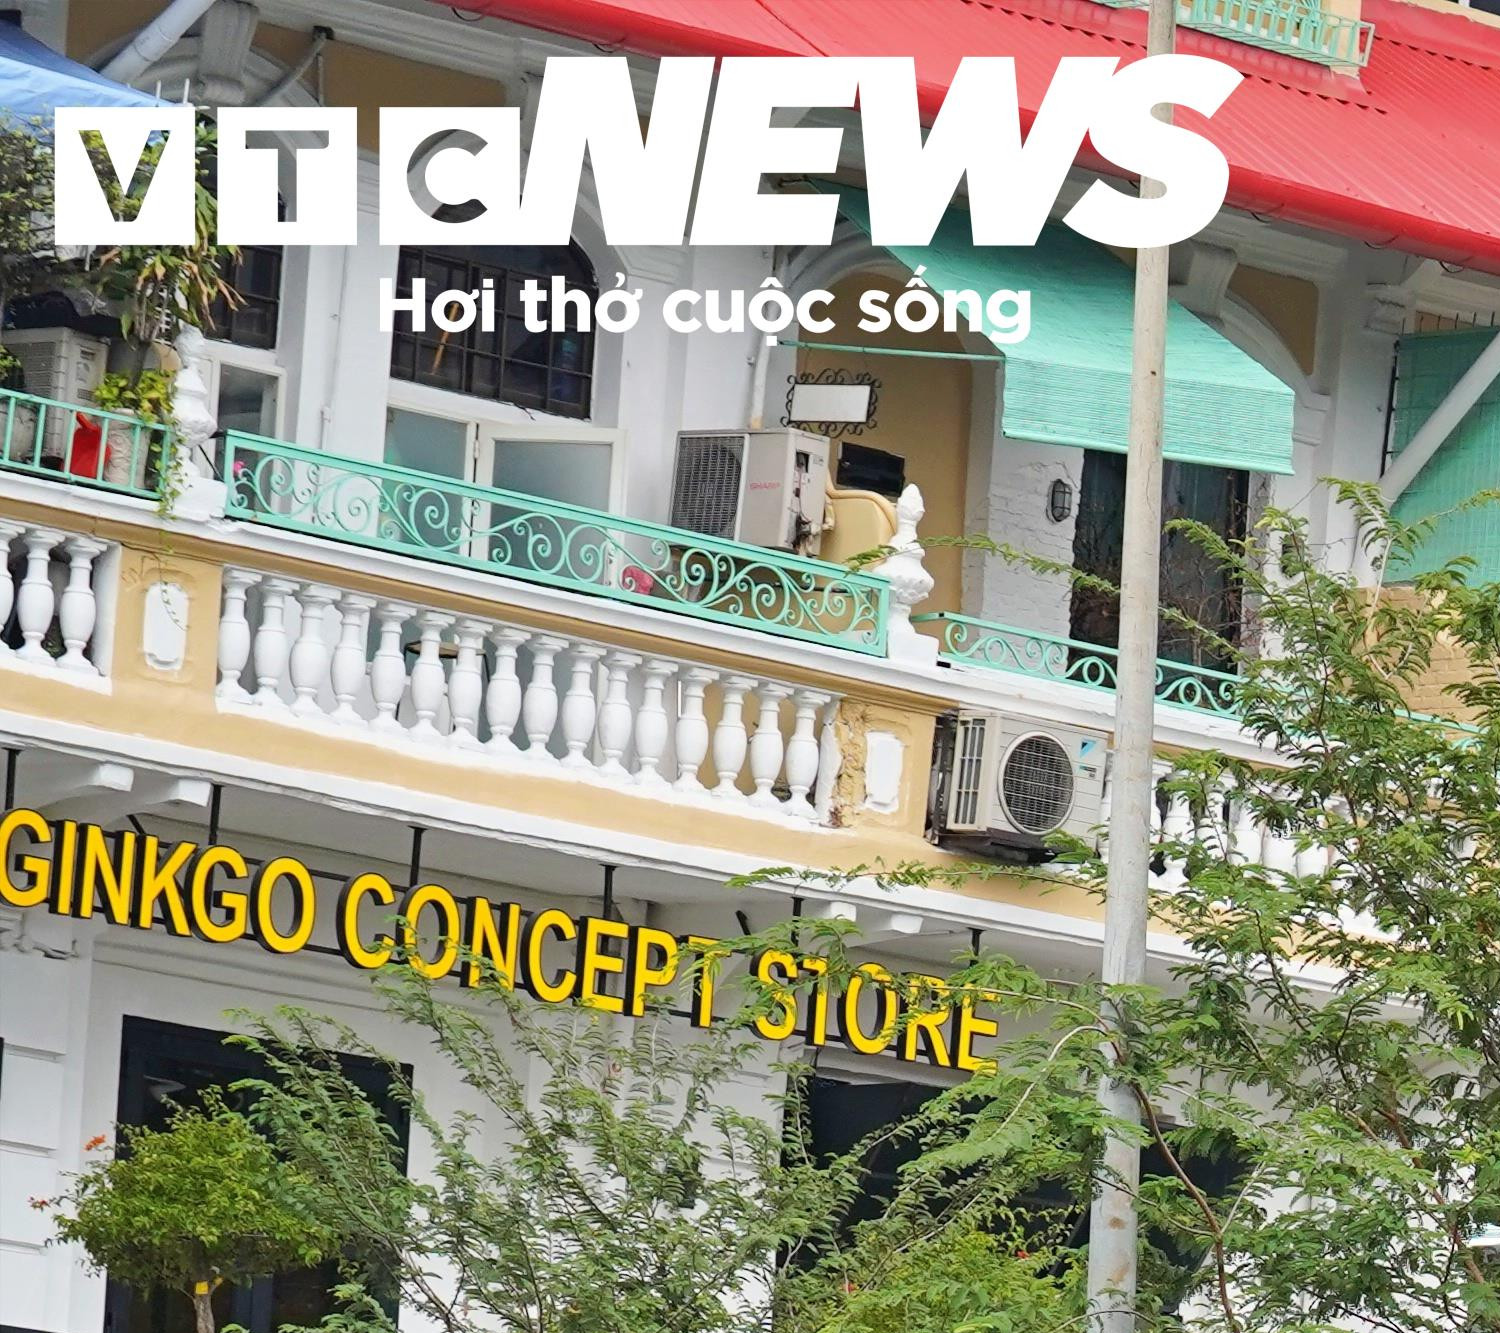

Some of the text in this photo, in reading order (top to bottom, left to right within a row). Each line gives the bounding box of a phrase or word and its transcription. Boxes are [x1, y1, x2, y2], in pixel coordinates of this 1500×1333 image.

[0, 808, 1001, 1074] GINKGO CONCEPT STORE
